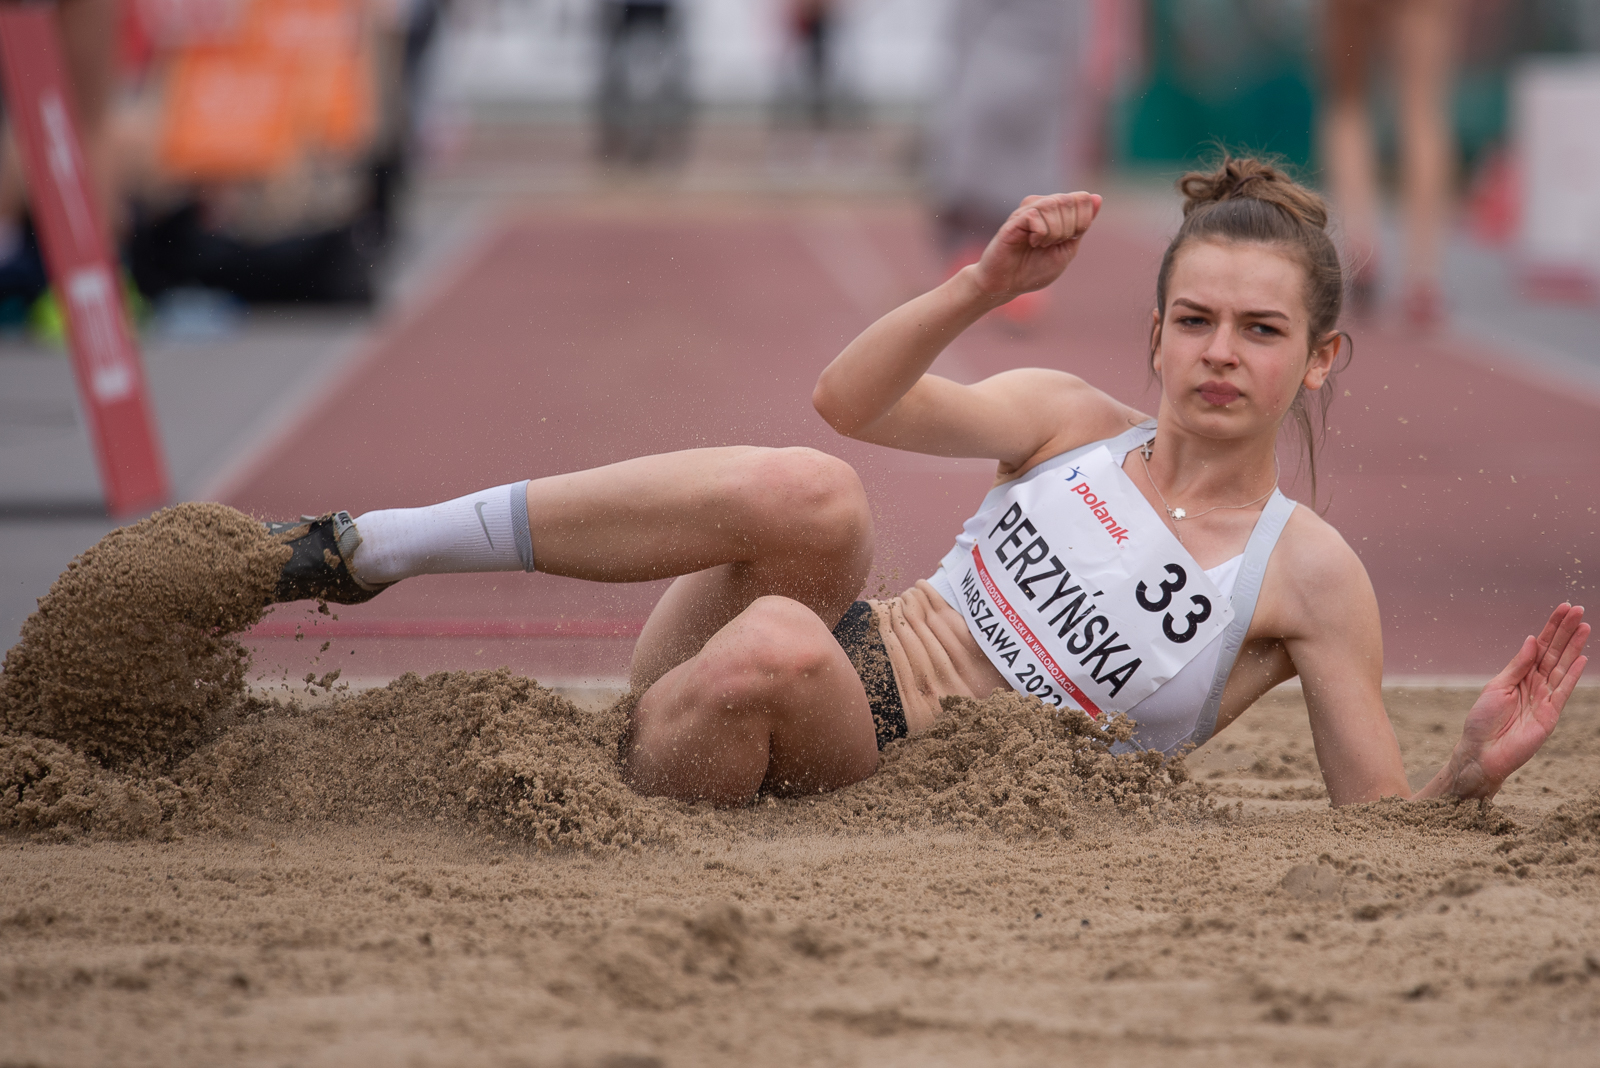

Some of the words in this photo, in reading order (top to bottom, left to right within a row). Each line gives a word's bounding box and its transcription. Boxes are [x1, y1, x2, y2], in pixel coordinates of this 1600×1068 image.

[1070, 482, 1129, 545] polanik
[960, 568, 1021, 668] WARSZAWA
[980, 568, 1007, 611] MISTRZOSTWA
[1005, 610, 1028, 635] POLSKI
[1025, 634, 1035, 644] W
[1032, 642, 1075, 693] WIELOBOJACH
[988, 502, 1142, 698] PERZYŃSKA
[1135, 563, 1212, 643] 33
